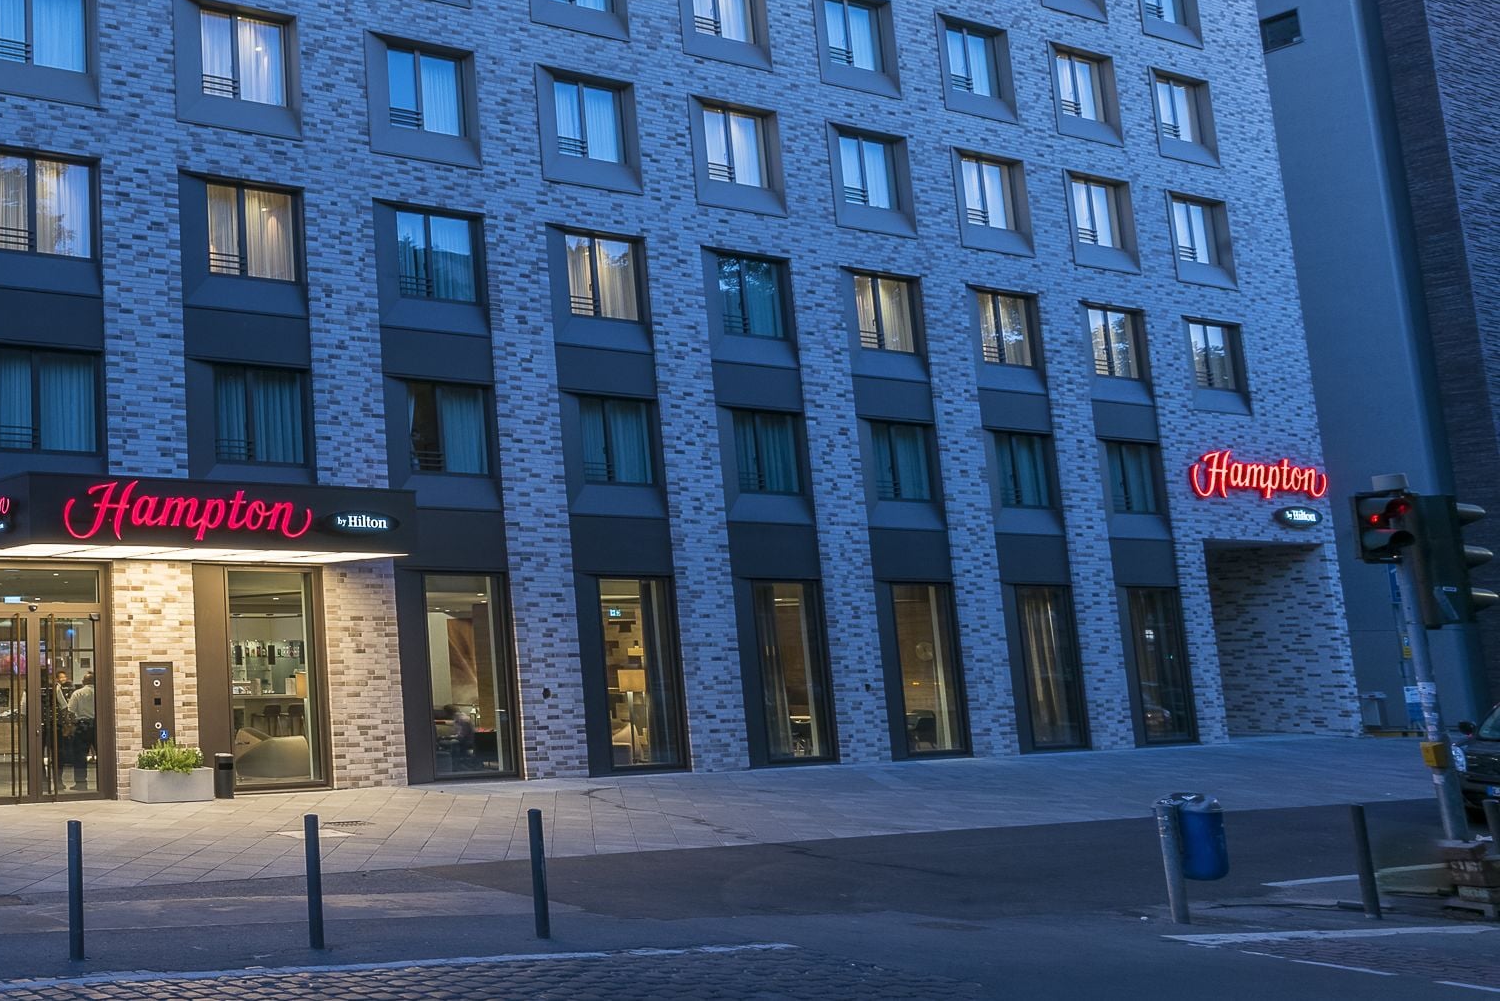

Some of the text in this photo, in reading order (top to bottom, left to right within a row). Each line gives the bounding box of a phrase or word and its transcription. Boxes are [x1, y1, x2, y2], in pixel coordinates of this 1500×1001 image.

[1190, 449, 1328, 499] Hampton
[64, 480, 312, 541] Hampton
[337, 514, 388, 529] by Hilton
[1292, 509, 1317, 522] Hilton
